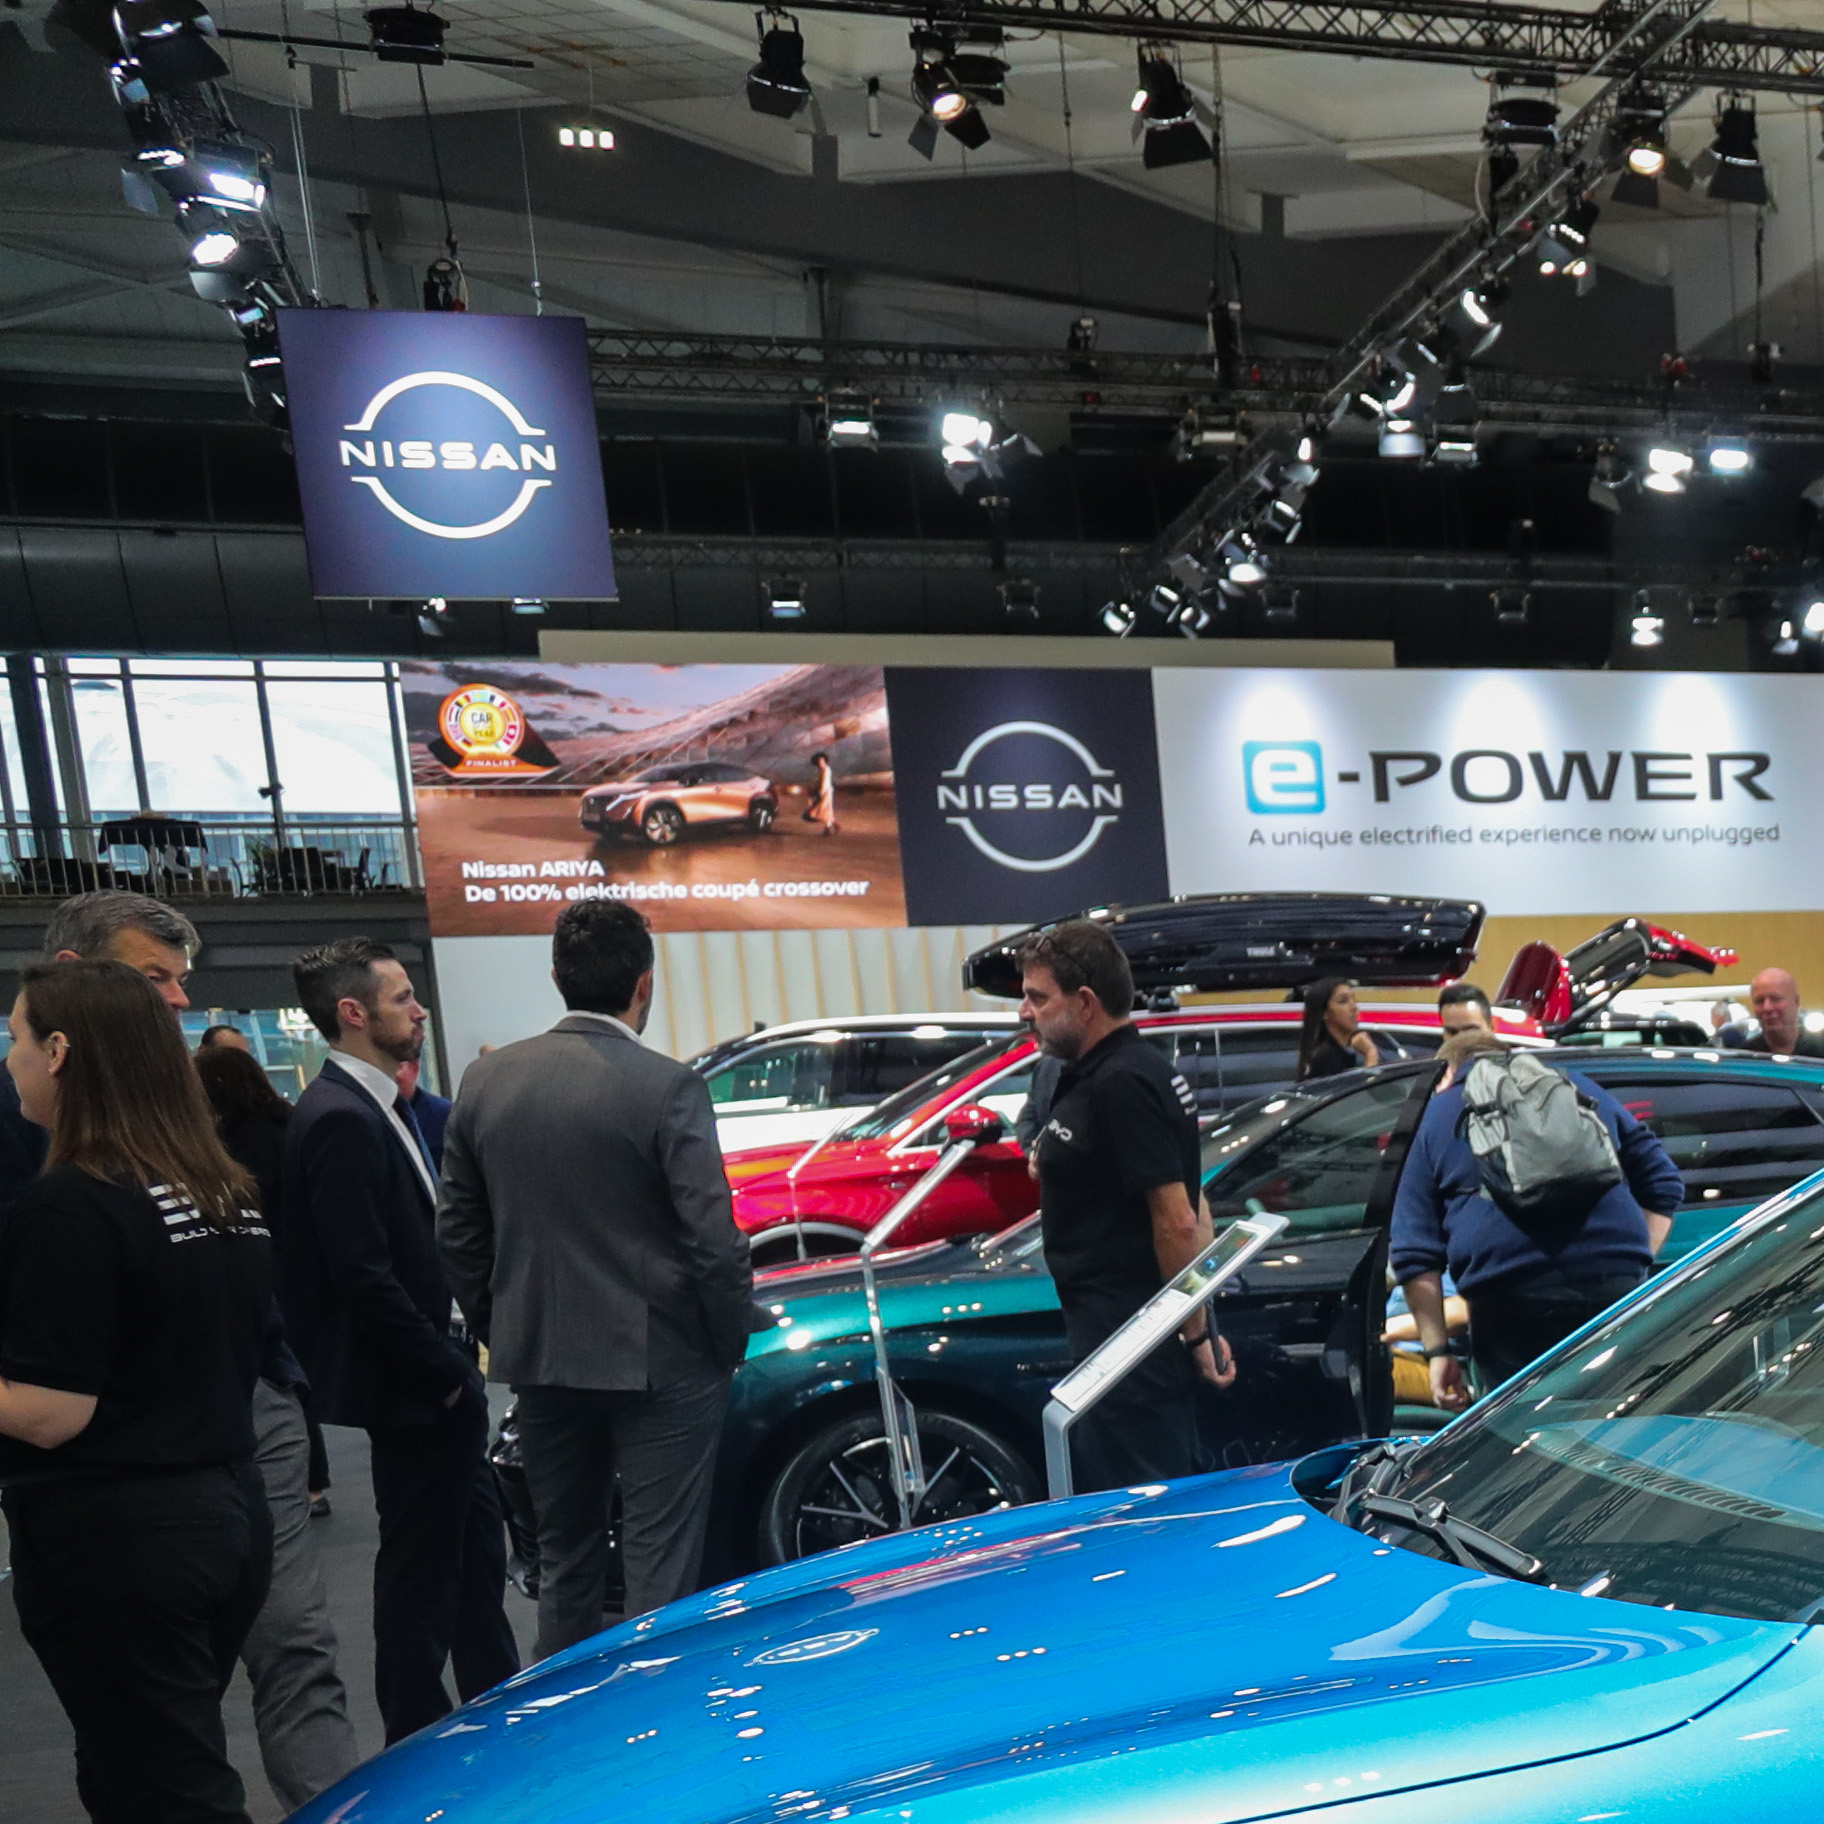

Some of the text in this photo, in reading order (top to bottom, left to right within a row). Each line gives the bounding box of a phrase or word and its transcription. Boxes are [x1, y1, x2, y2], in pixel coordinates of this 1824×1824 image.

[339, 440, 557, 471] NISSAN
[938, 784, 1122, 810] NISSAN
[1248, 822, 1781, 849] A unique electrified experience now unplugged
[462, 860, 605, 878] Nissan ARIYA
[465, 877, 869, 902] De 100% elektrische coupé crossover
